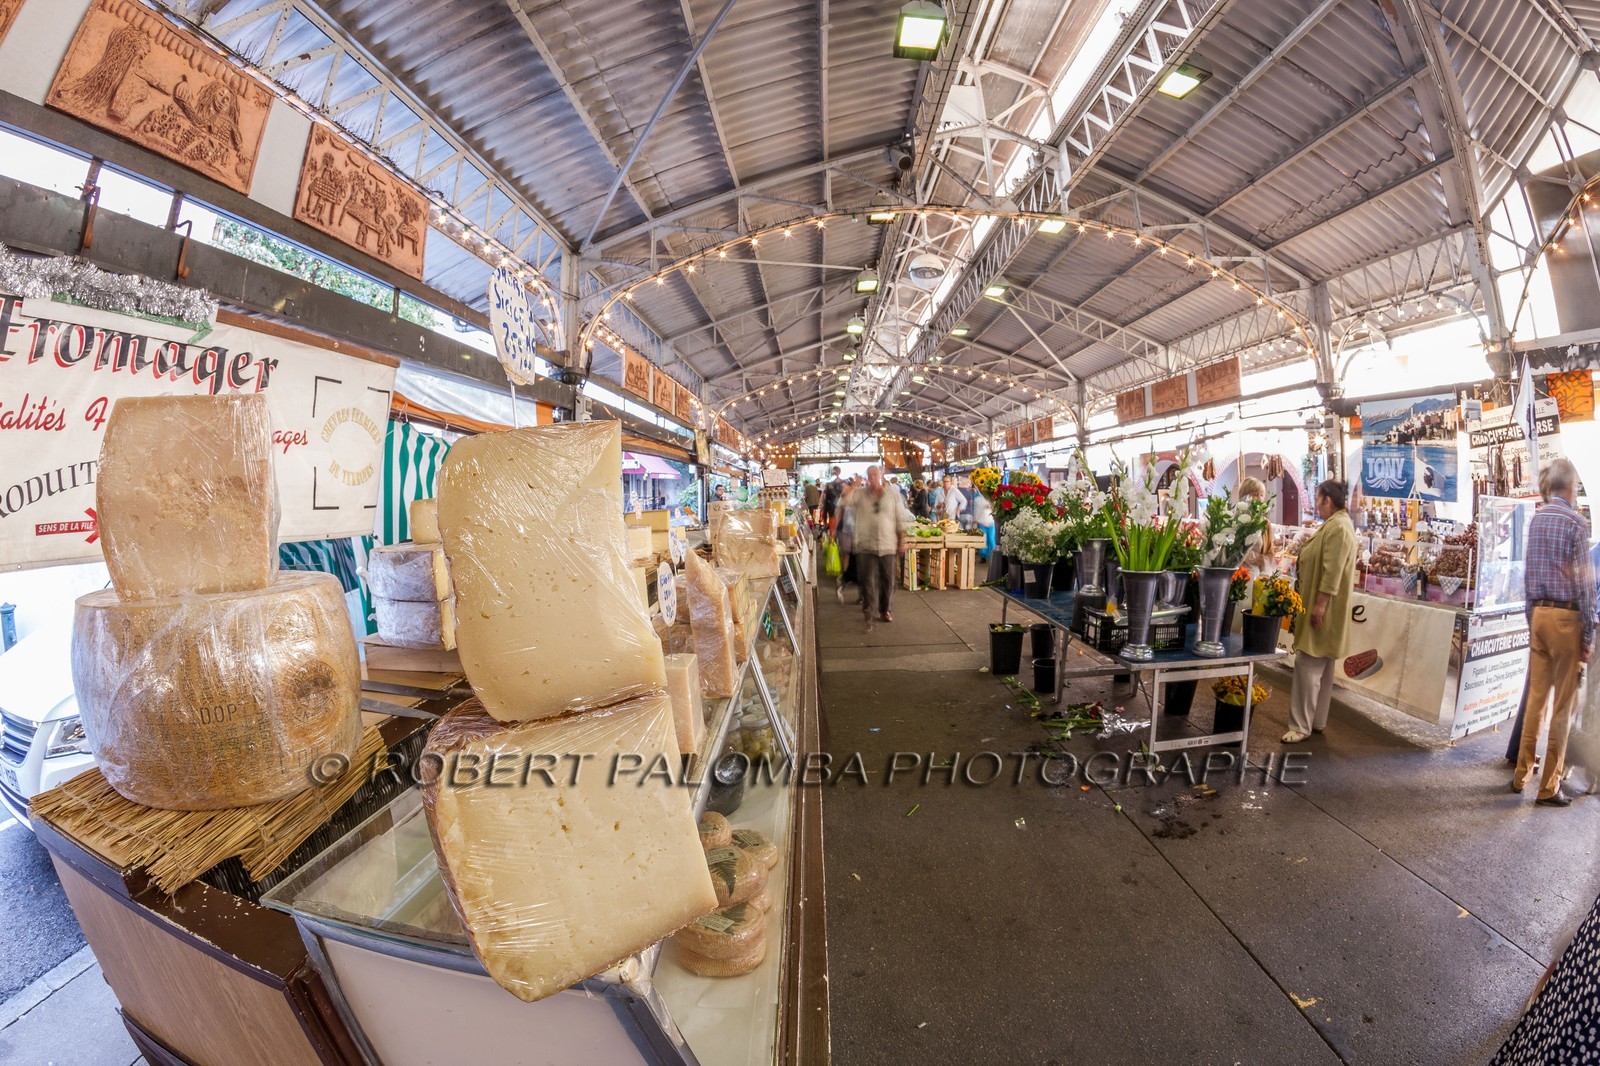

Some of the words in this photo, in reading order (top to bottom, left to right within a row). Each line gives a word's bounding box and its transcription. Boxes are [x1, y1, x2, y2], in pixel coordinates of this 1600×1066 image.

[0, 392, 66, 431] alités
[1537, 418, 1555, 434] RSE
[1366, 457, 1406, 479] TONY
[38, 524, 57, 533] SENS
[59, 523, 69, 531] DE
[70, 522, 79, 531] LA
[81, 521, 94, 530] FILE
[1471, 635, 1512, 658] CHARCUTERIE
[1512, 631, 1531, 648] CORSE
